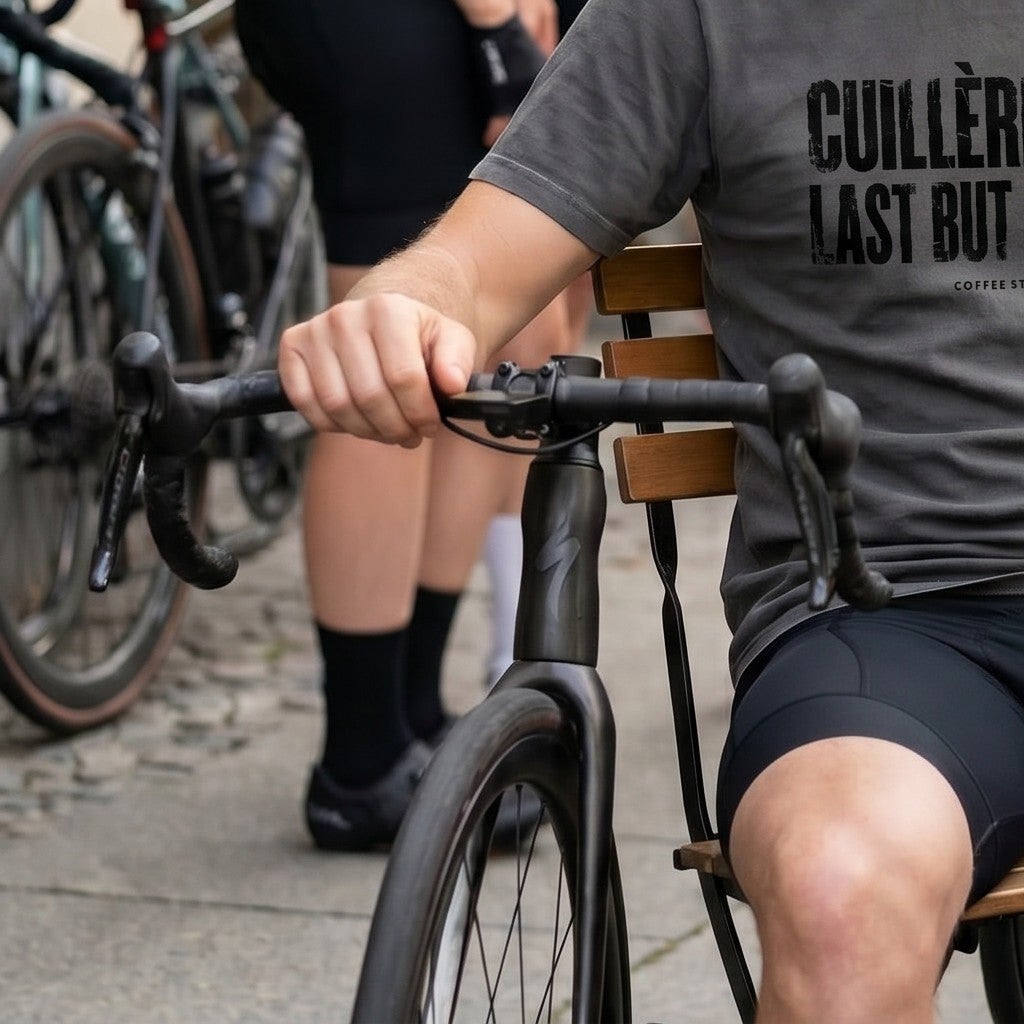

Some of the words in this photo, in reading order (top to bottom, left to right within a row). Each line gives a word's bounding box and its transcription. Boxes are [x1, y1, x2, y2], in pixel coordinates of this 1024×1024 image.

[809, 182, 917, 265] LAST
[930, 179, 1013, 263] BUT
[954, 280, 1006, 291] COFFEE
